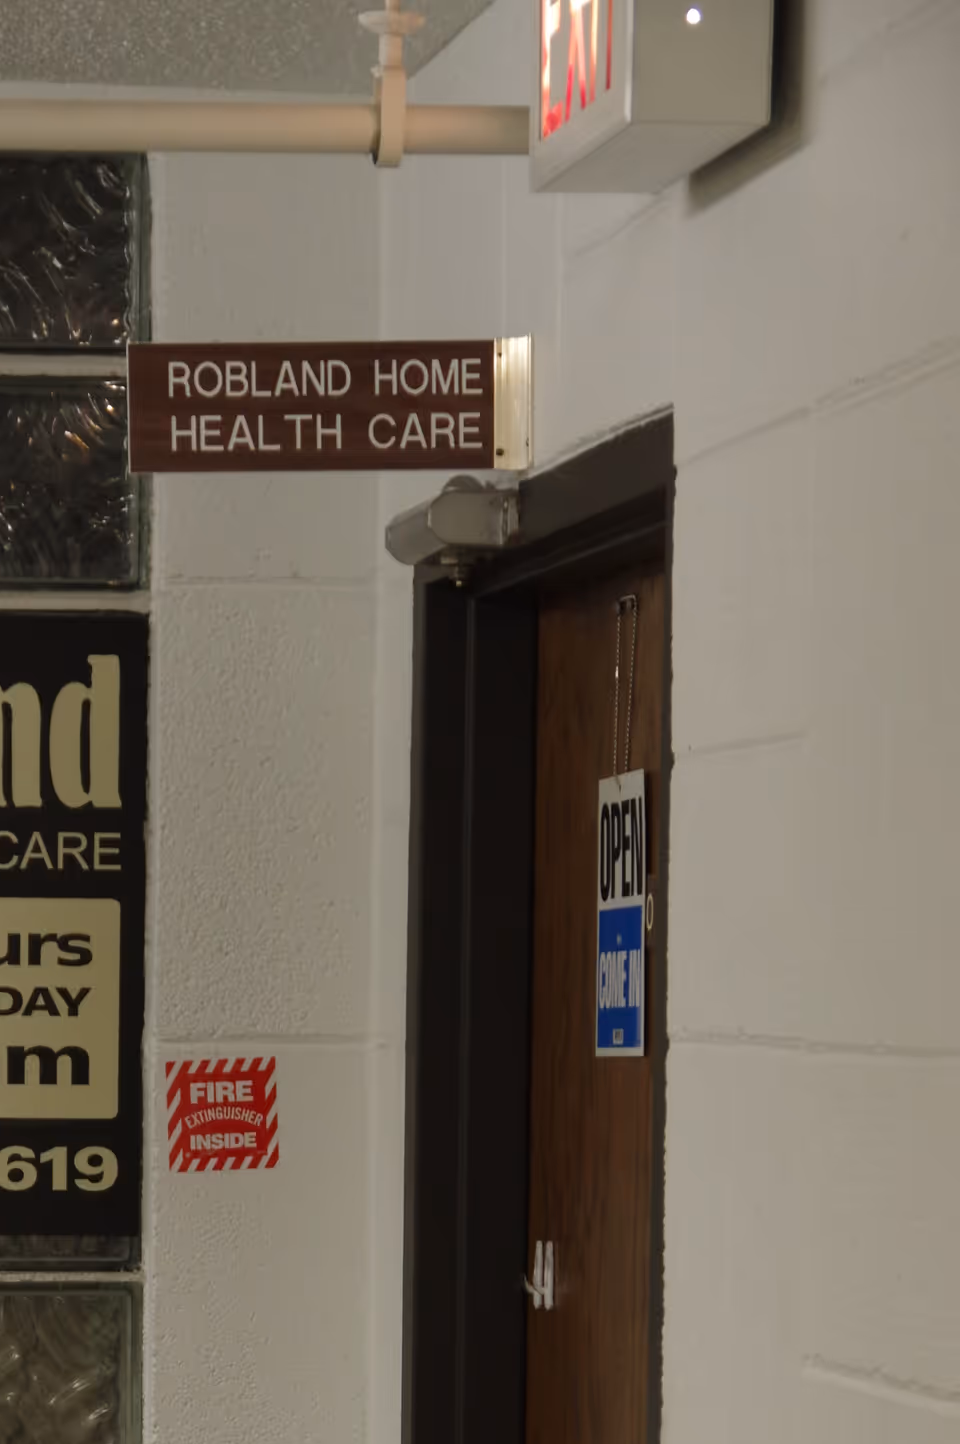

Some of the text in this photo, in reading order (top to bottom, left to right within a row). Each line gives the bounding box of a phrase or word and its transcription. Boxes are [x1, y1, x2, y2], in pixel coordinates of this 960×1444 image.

[167, 357, 483, 399] ROBLAND HOME
[171, 411, 483, 453] HEALTH CARE
[599, 796, 642, 902] OPEN
[599, 949, 641, 1009] COME IN
[189, 1080, 254, 1104] FIRE
[184, 1106, 263, 1130] EXTINGUISHER
[189, 1131, 257, 1151] INSIDE
